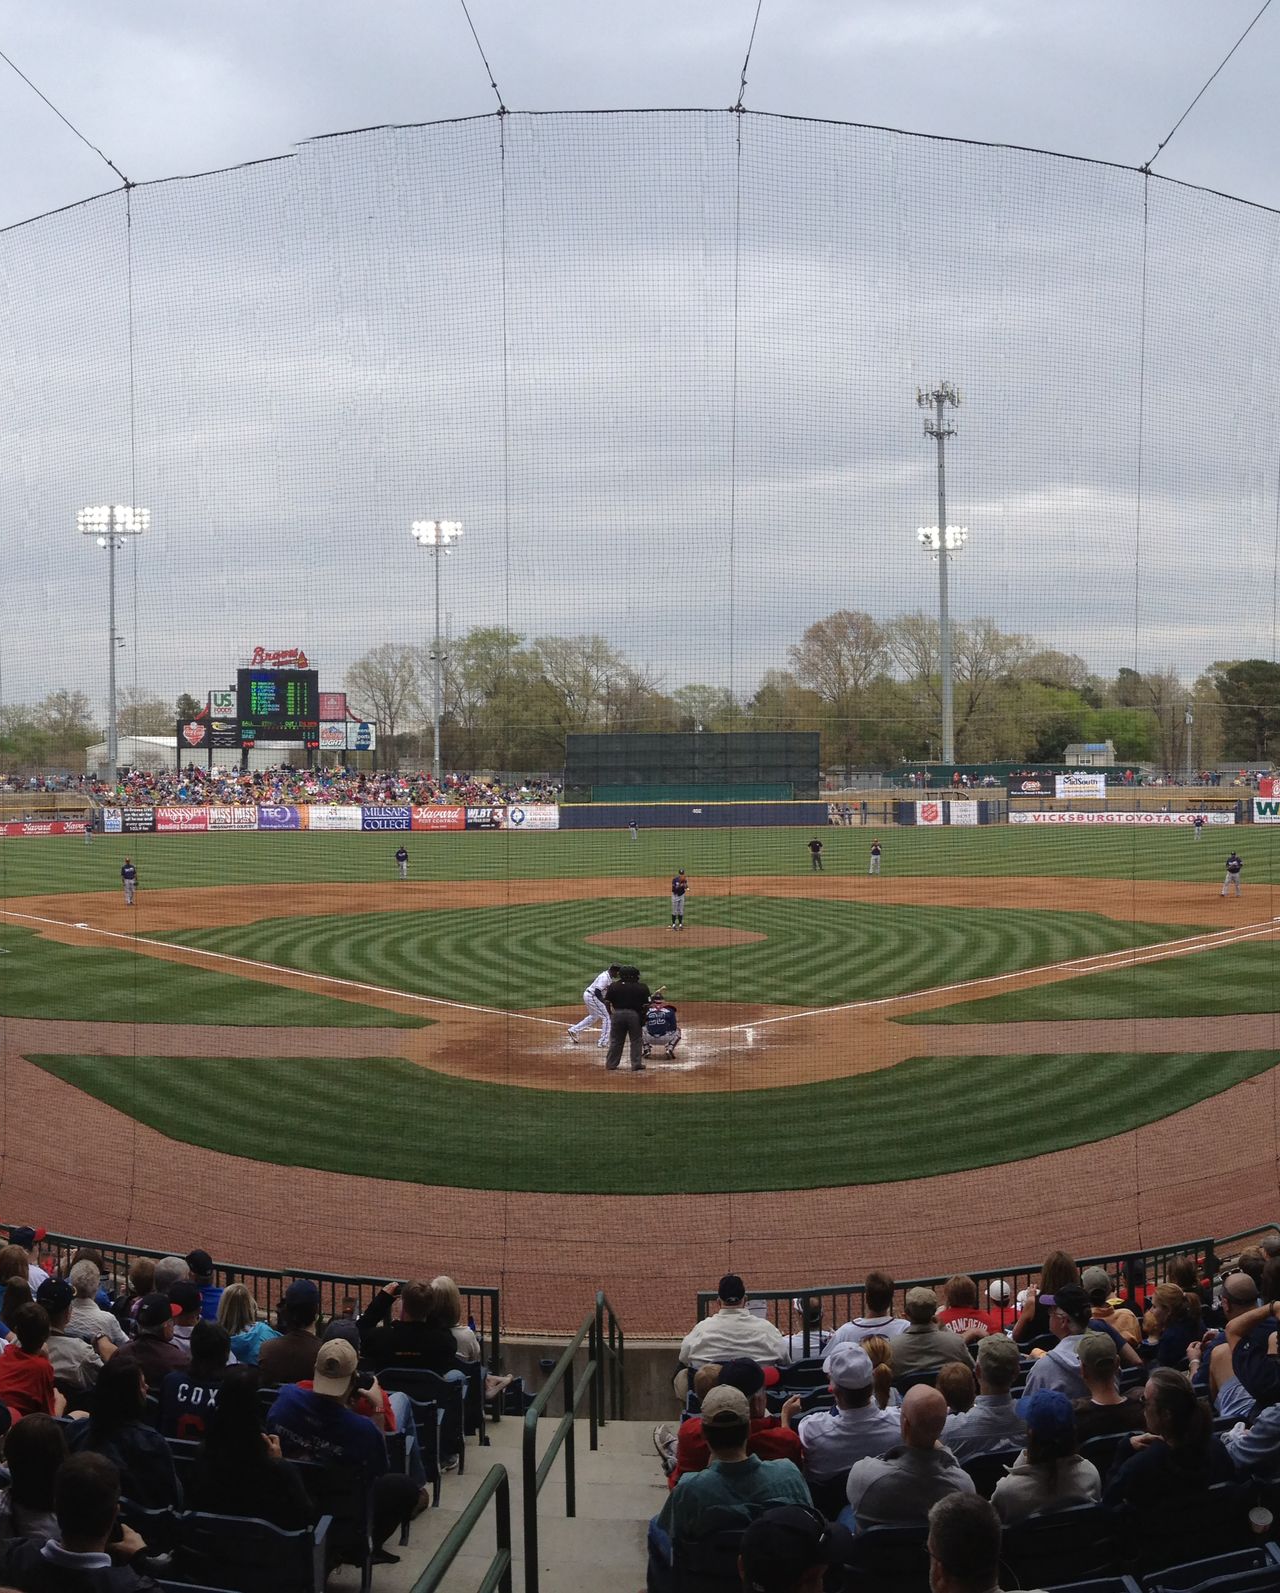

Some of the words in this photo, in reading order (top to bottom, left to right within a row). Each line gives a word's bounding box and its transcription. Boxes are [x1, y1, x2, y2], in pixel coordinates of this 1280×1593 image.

[252, 647, 299, 665] Braves
[158, 807, 205, 823] MISSISSIPPI
[262, 808, 280, 818] TEC
[364, 807, 409, 817] MILLSAPS
[467, 809, 491, 818] WLBT
[364, 819, 409, 830] COLLEGE
[177, 1383, 219, 1407] COX
